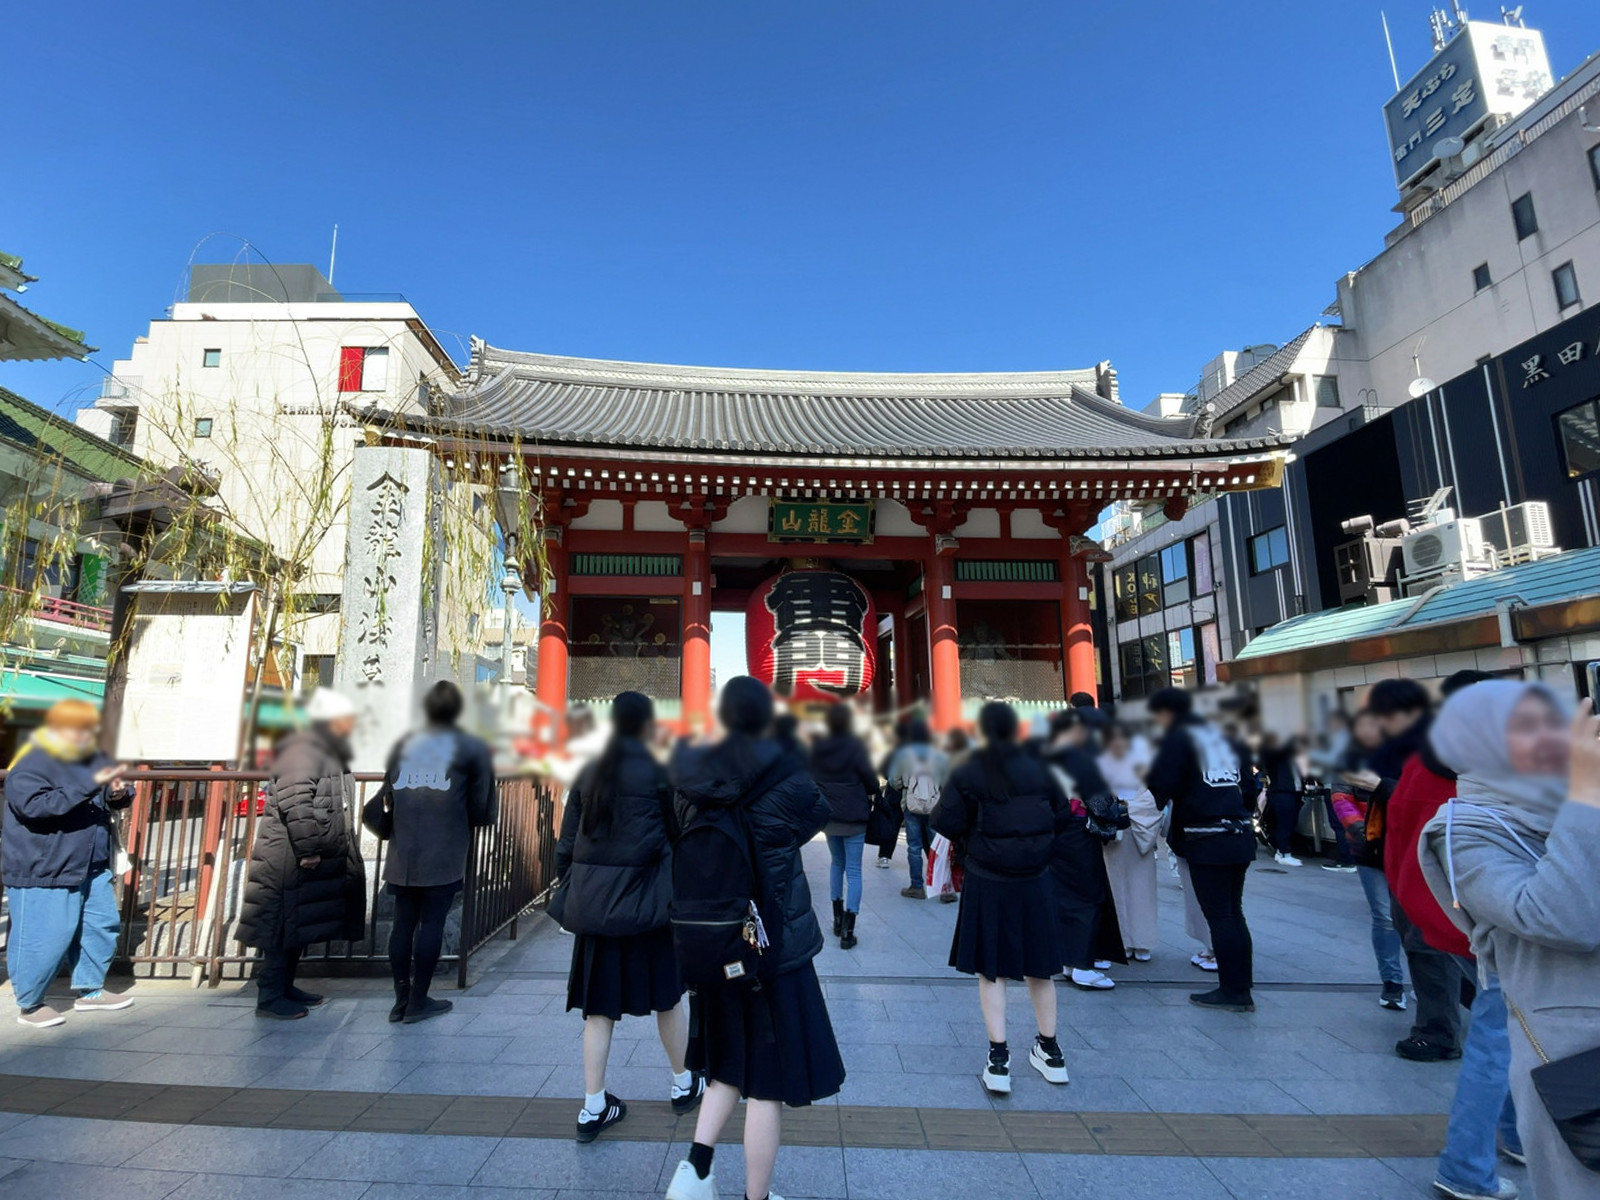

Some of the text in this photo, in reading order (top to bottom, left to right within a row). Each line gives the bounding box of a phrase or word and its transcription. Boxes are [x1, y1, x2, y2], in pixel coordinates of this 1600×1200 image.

[1402, 62, 1456, 118] 天ぷら
[1521, 335, 1600, 389] 黒田
